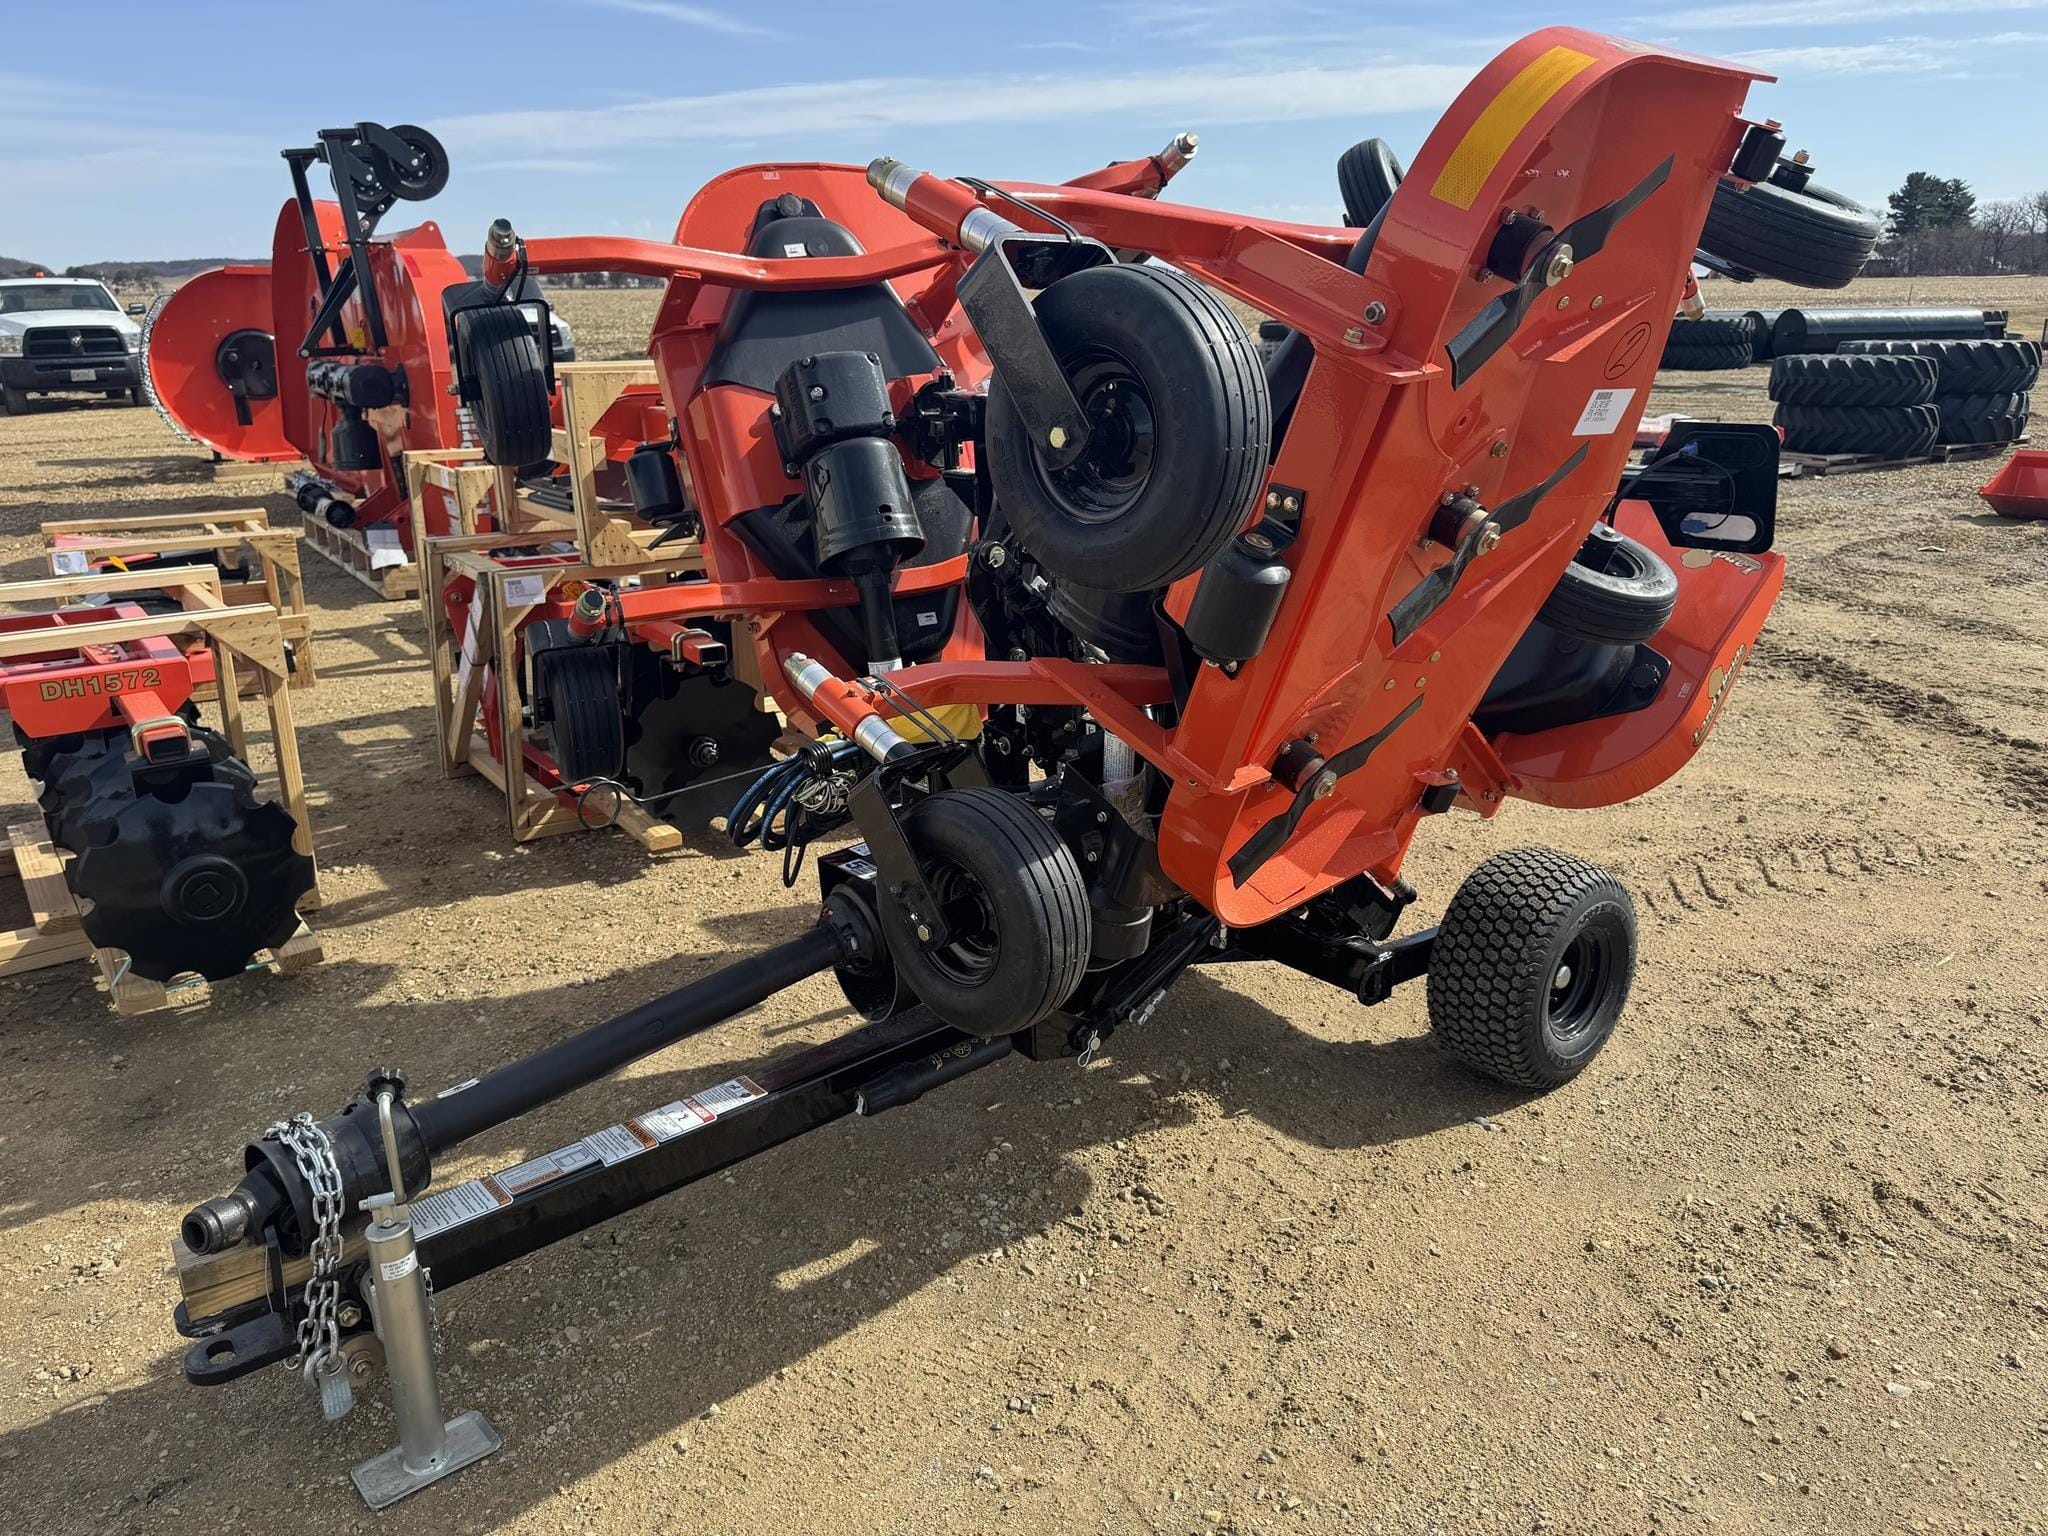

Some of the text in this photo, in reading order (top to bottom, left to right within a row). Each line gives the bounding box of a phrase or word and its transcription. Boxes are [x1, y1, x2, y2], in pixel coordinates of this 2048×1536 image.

[1609, 328, 1646, 372] 2
[40, 668, 161, 702] DH1572
[686, 1098, 711, 1119] DANGER
[629, 1121, 653, 1145] WARNING
